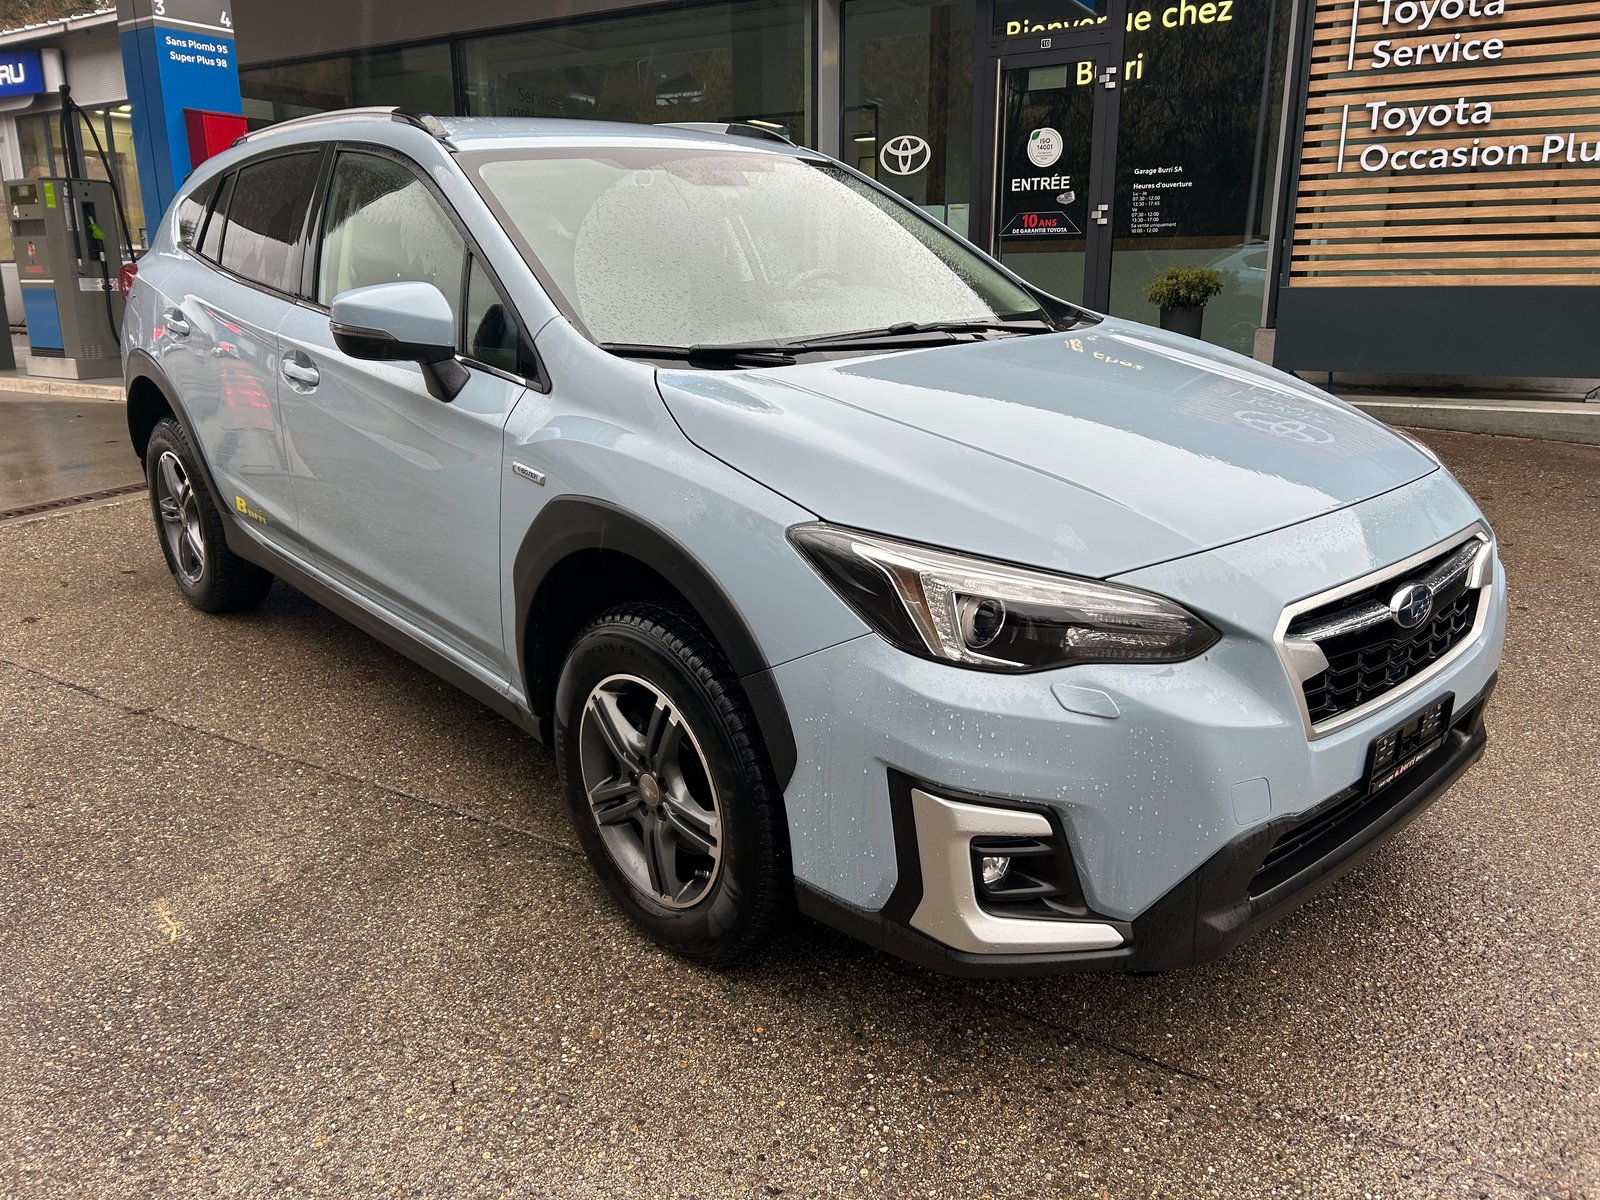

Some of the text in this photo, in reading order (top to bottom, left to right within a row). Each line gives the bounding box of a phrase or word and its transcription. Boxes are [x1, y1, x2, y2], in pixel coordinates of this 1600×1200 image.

[154, 0, 231, 27] 3 4
[1162, 0, 1233, 28] chez
[1377, 0, 1505, 30] Toyota
[165, 36, 228, 54] Sans Plomb 95
[1370, 33, 1504, 69] Service
[169, 51, 228, 68] Super Plus 98
[518, 86, 557, 109] Service
[1365, 97, 1493, 137] Toyota
[1359, 137, 1529, 173] Occasion
[1174, 165, 1183, 173] SA
[1011, 173, 1071, 192] ENTRÉE
[13, 205, 19, 218] 4
[1022, 213, 1057, 228] 10 ANS
